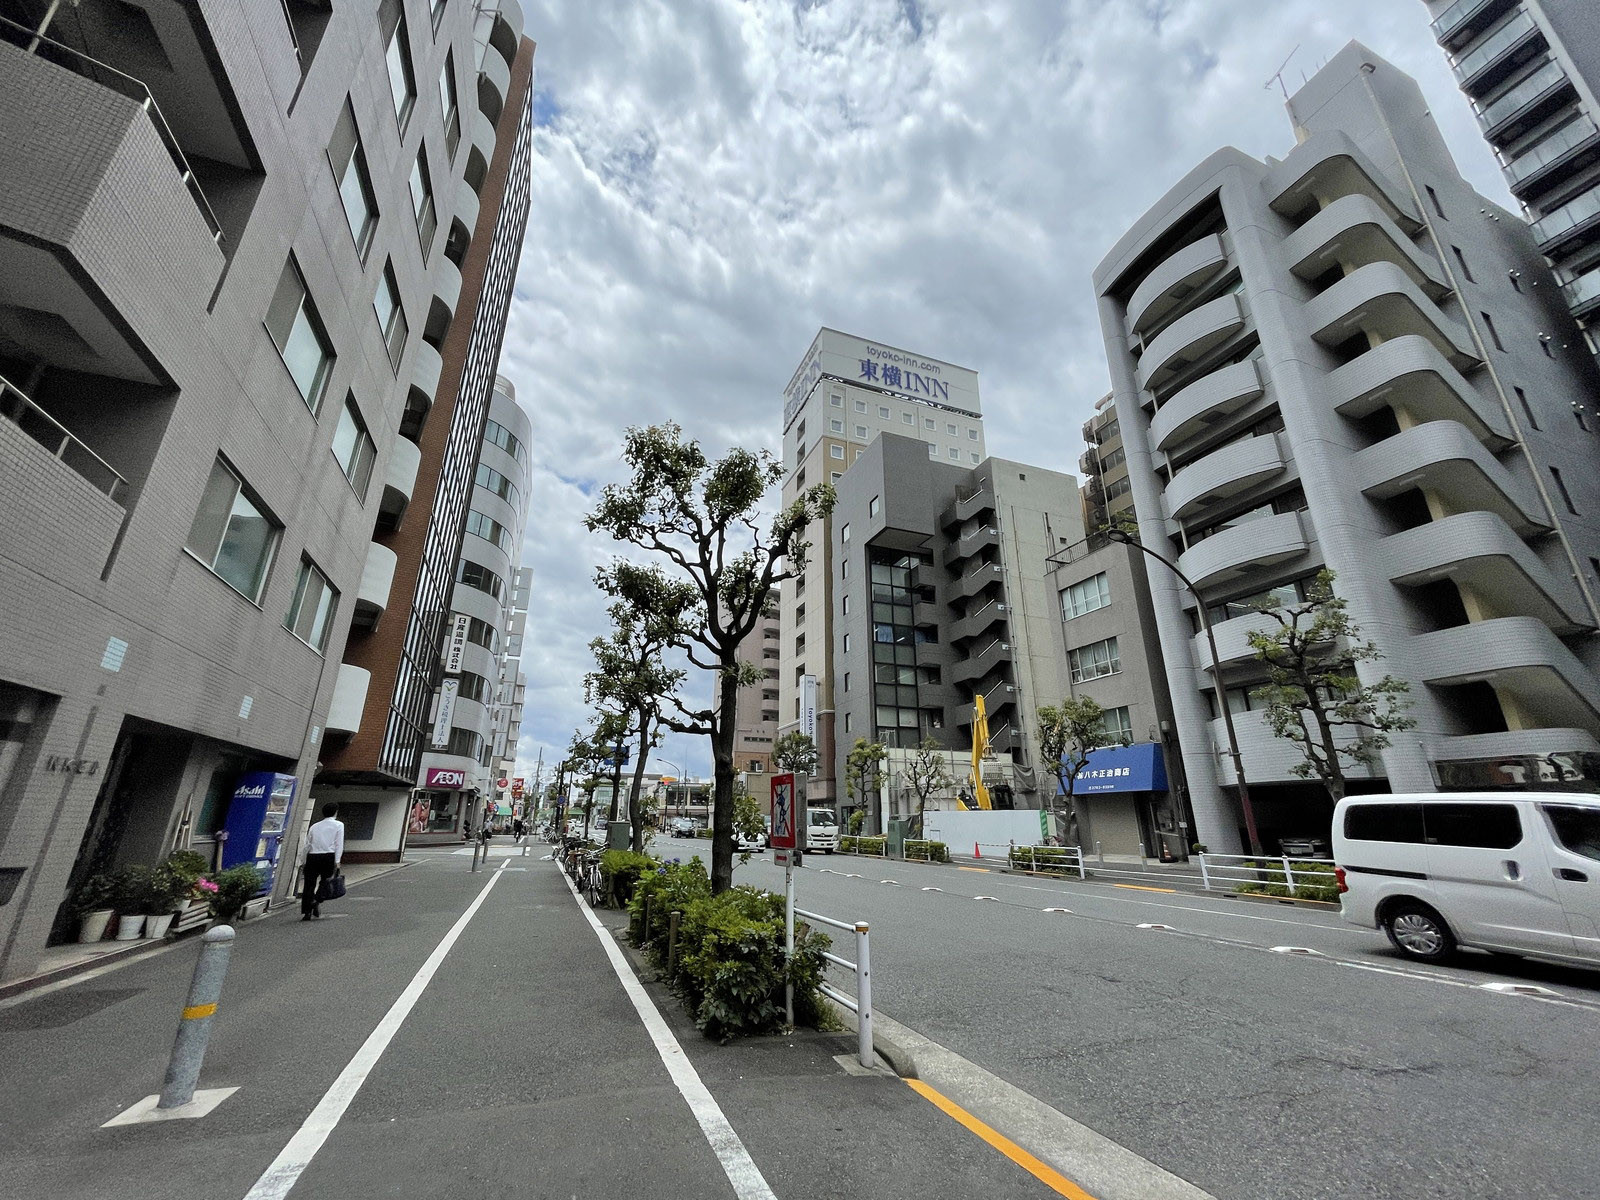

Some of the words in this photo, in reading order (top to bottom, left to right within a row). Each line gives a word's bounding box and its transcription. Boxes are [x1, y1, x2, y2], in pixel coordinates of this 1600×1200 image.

[866, 345, 941, 374] toyoko-inn.com
[858, 358, 949, 401] 東横INN
[234, 784, 266, 795] Asahi
